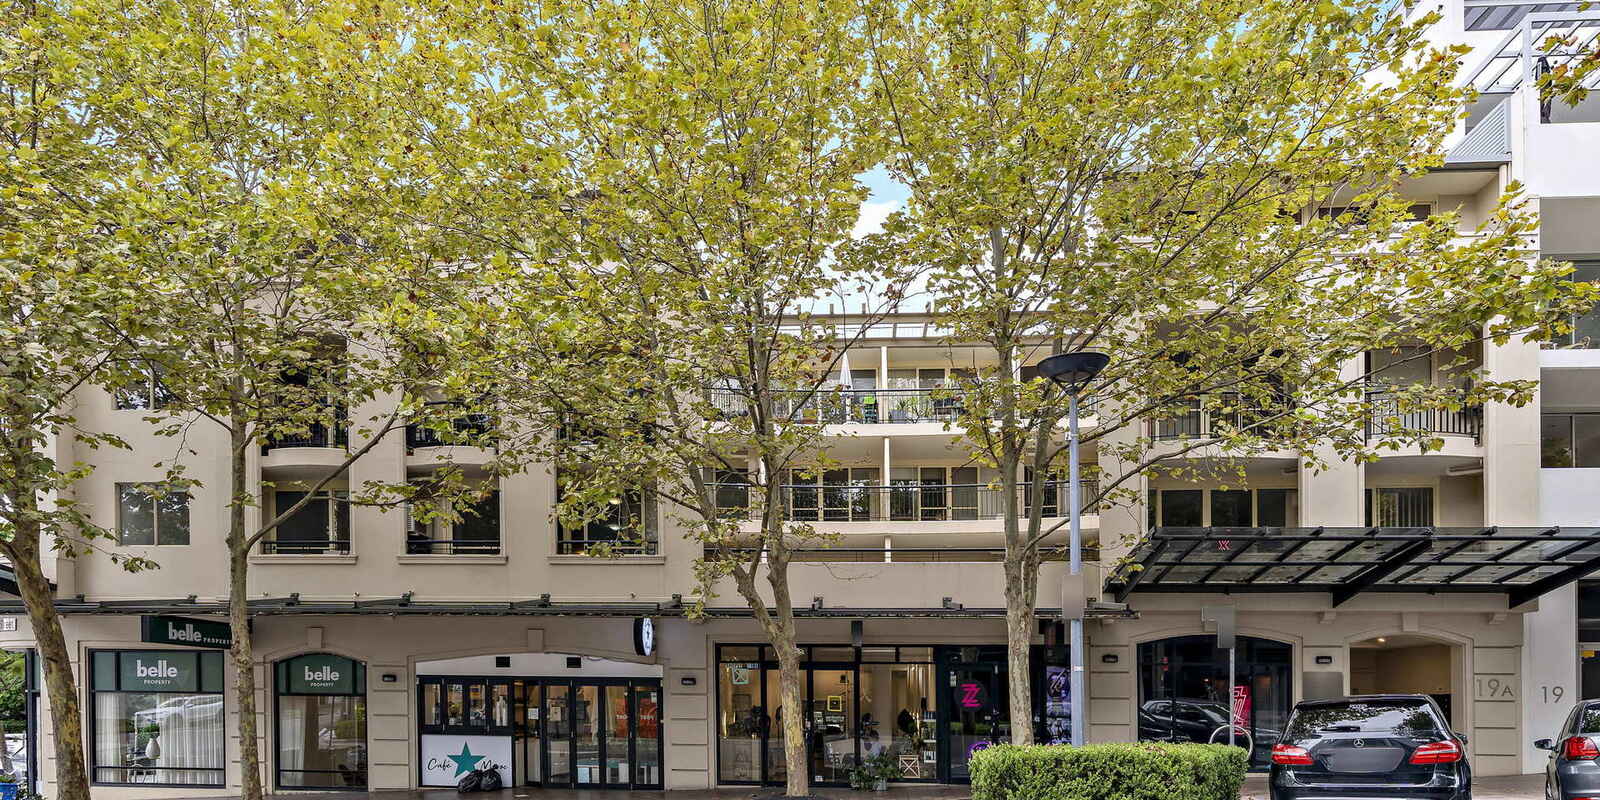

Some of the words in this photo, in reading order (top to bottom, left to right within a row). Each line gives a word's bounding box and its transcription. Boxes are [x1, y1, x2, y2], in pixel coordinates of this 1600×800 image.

[168, 621, 202, 642] belle
[136, 659, 178, 678] belle
[304, 665, 340, 681] belle
[1475, 678, 1514, 697] 19A
[1541, 685, 1564, 704] 19
